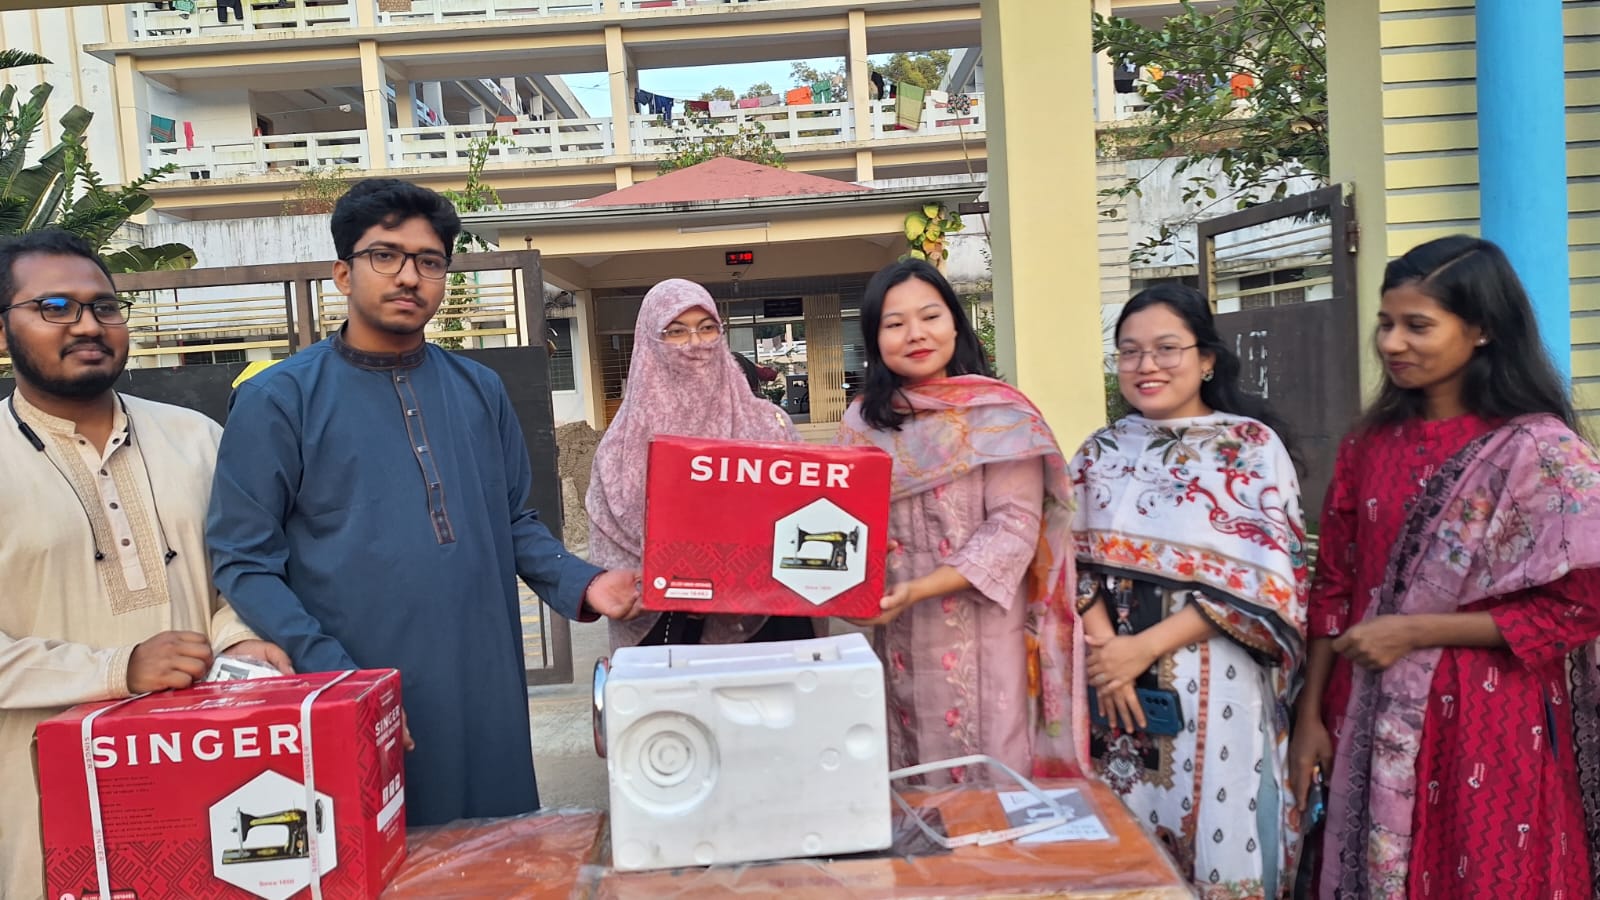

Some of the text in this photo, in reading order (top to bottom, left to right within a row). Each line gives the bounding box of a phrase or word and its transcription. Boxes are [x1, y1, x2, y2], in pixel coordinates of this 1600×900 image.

[690, 455, 850, 489] SINGER
[374, 704, 400, 738] SINGER
[84, 736, 93, 770] SINGER
[92, 723, 301, 769] SINGER
